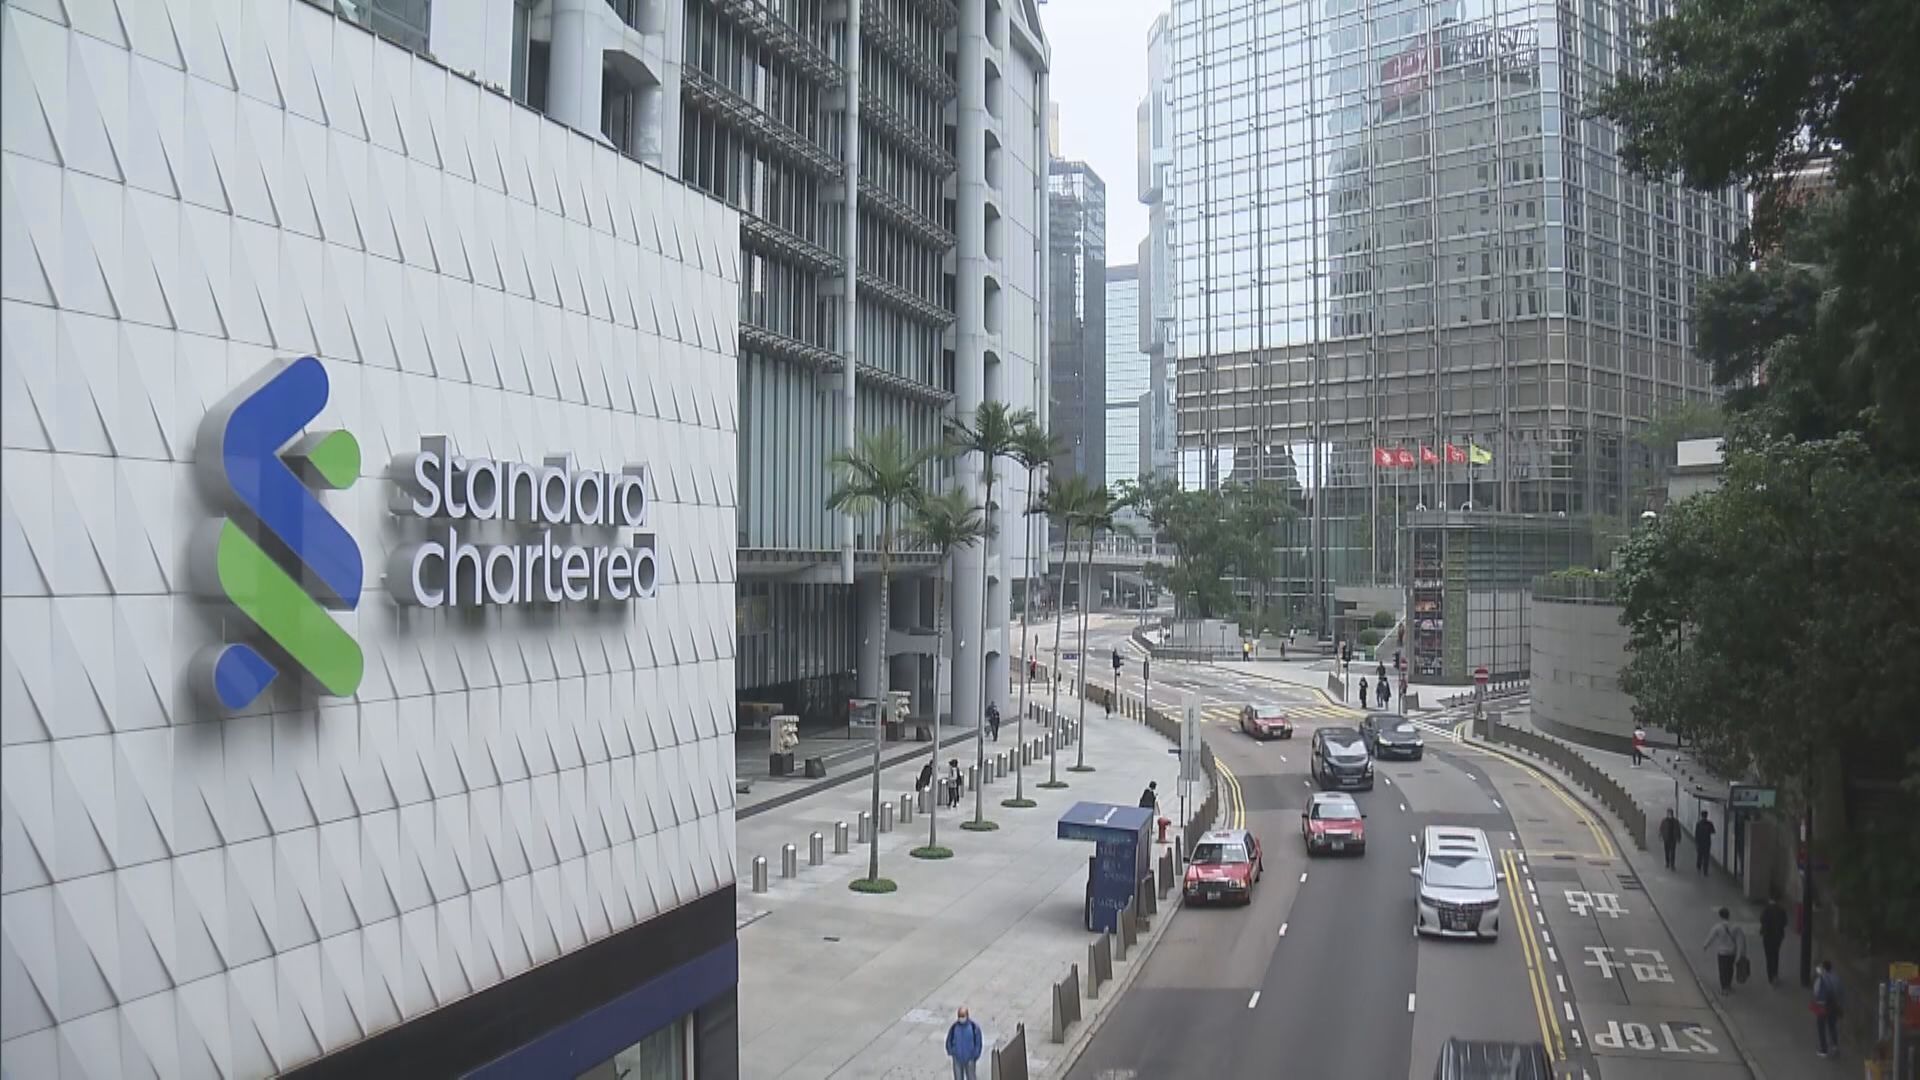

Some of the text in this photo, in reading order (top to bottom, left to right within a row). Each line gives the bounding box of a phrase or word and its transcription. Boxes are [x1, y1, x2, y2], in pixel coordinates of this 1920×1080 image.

[412, 437, 648, 527] standard
[412, 527, 658, 608] chartered
[1594, 1020, 1719, 1054] STOP
